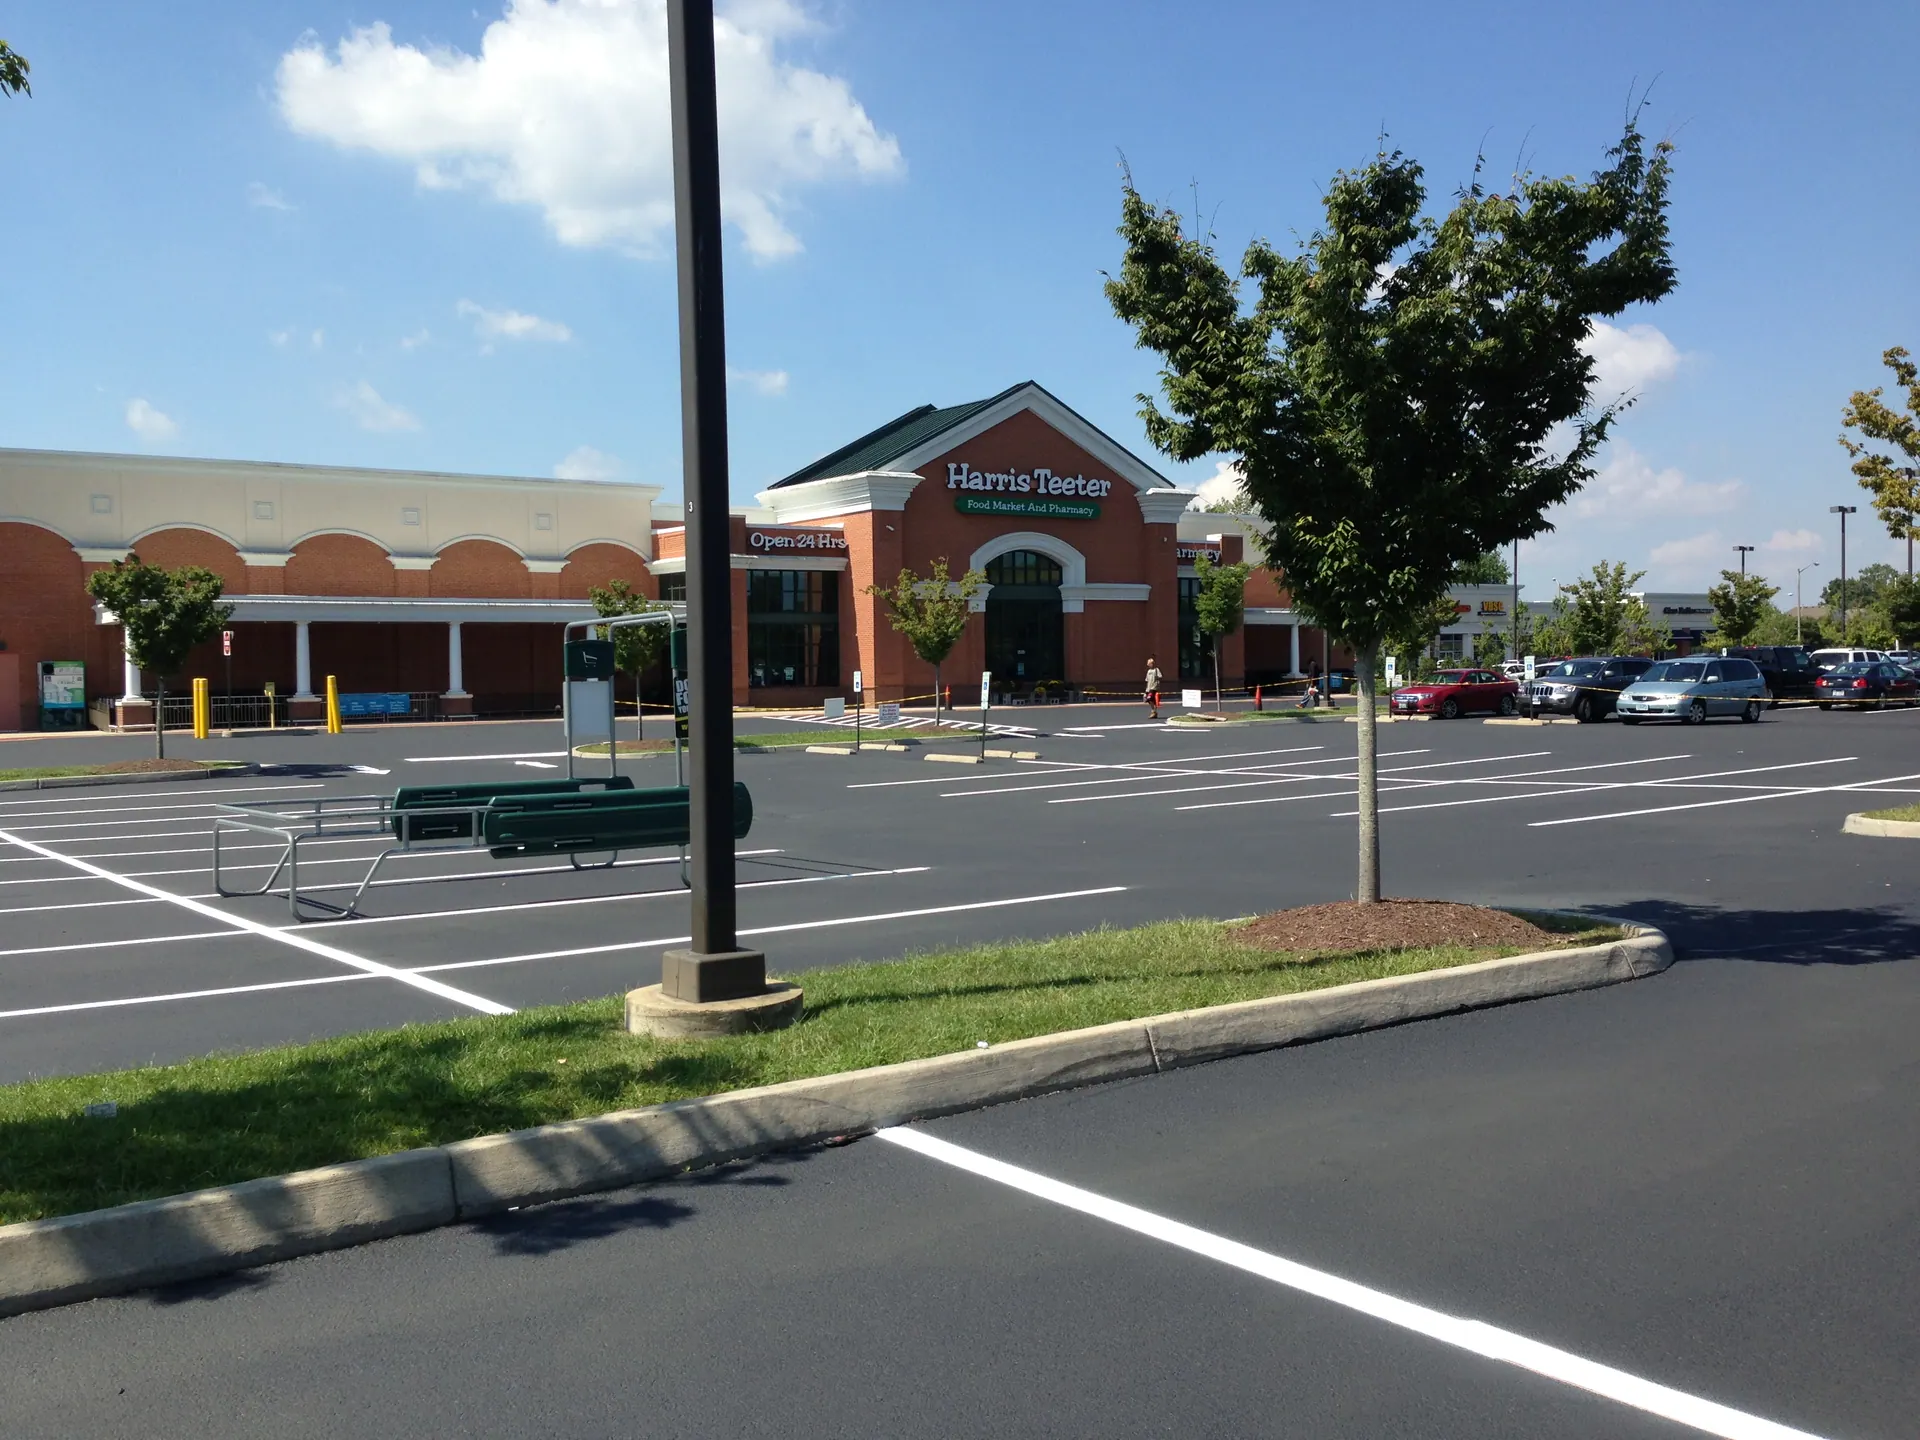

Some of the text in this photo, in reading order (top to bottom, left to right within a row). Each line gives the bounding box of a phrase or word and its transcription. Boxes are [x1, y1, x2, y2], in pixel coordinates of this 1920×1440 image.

[947, 463, 1111, 497] Harris Teeter
[967, 500, 1094, 516] Food Market And Pharmacy
[750, 532, 848, 551] Open 24 Hrs
